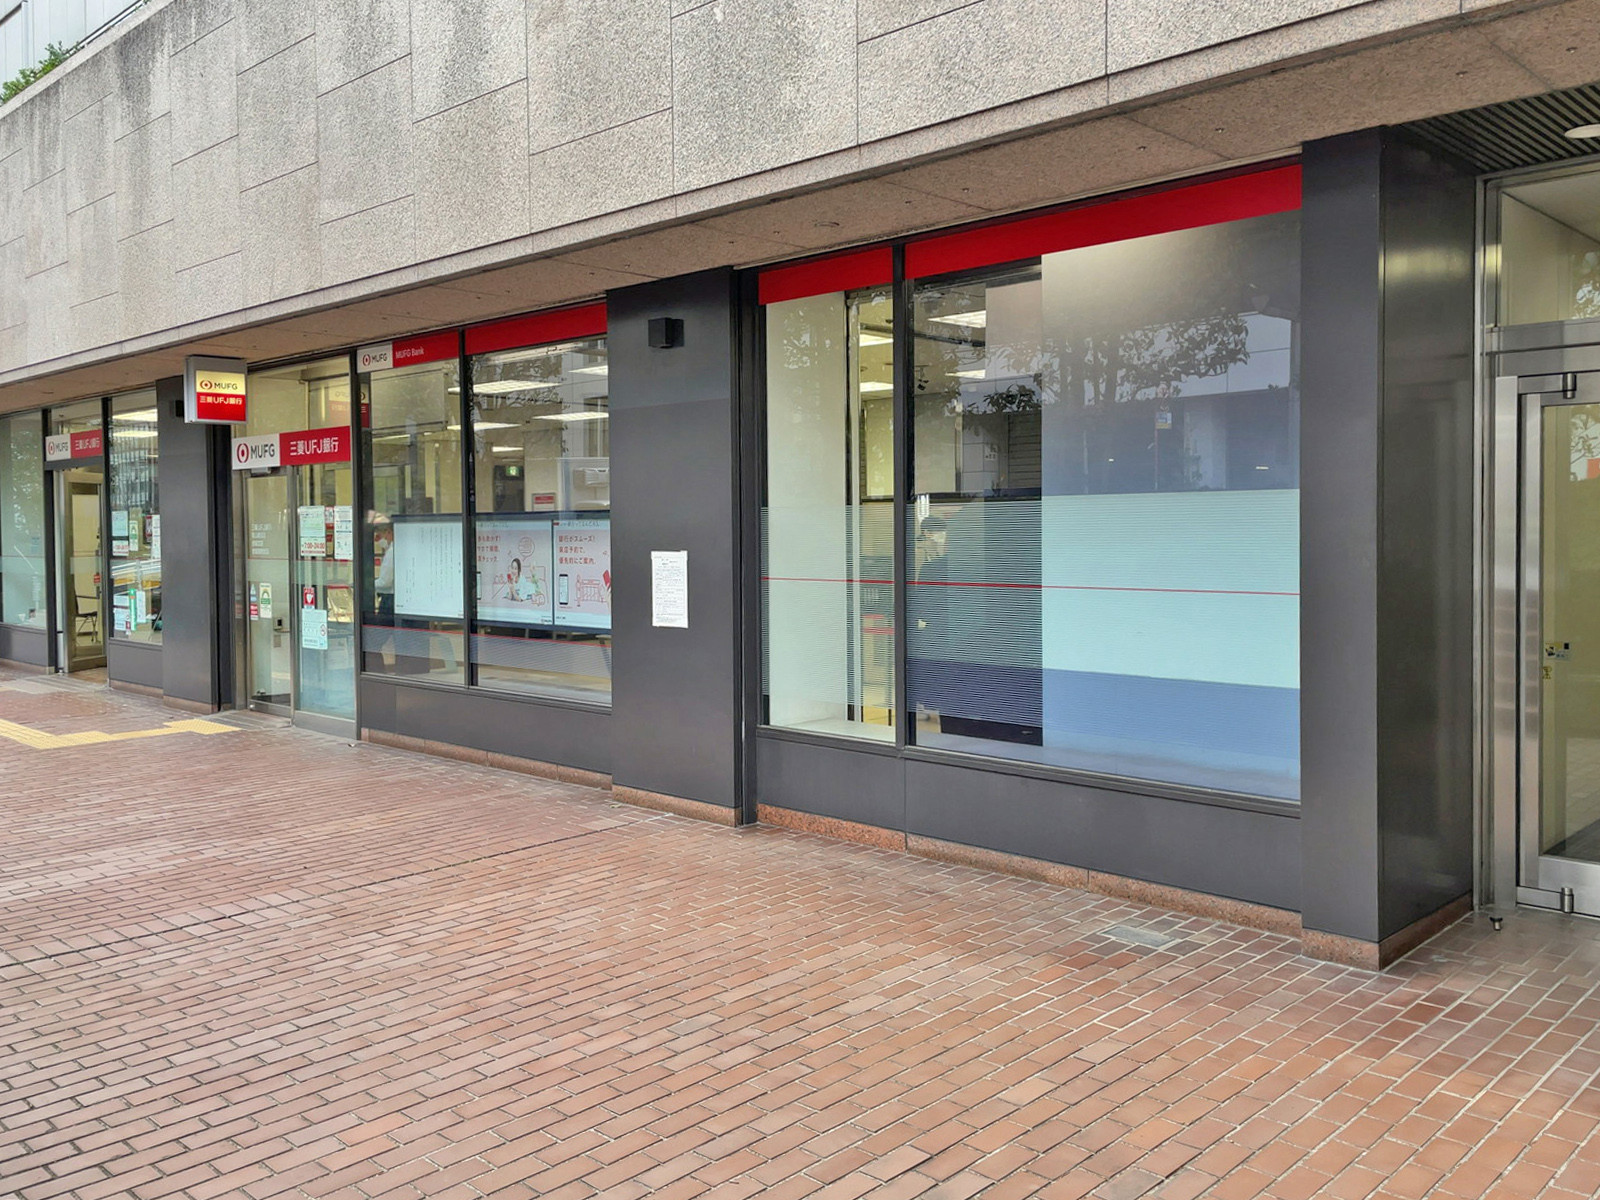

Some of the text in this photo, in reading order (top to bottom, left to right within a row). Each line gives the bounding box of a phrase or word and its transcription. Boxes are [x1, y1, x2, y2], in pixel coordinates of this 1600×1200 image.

[371, 347, 425, 364] MUFG MUFG Bank
[213, 382, 238, 390] MUFG
[199, 395, 243, 405] 三菱UFJ銀行
[250, 436, 339, 459] MUFG 三菱UFJ銀行
